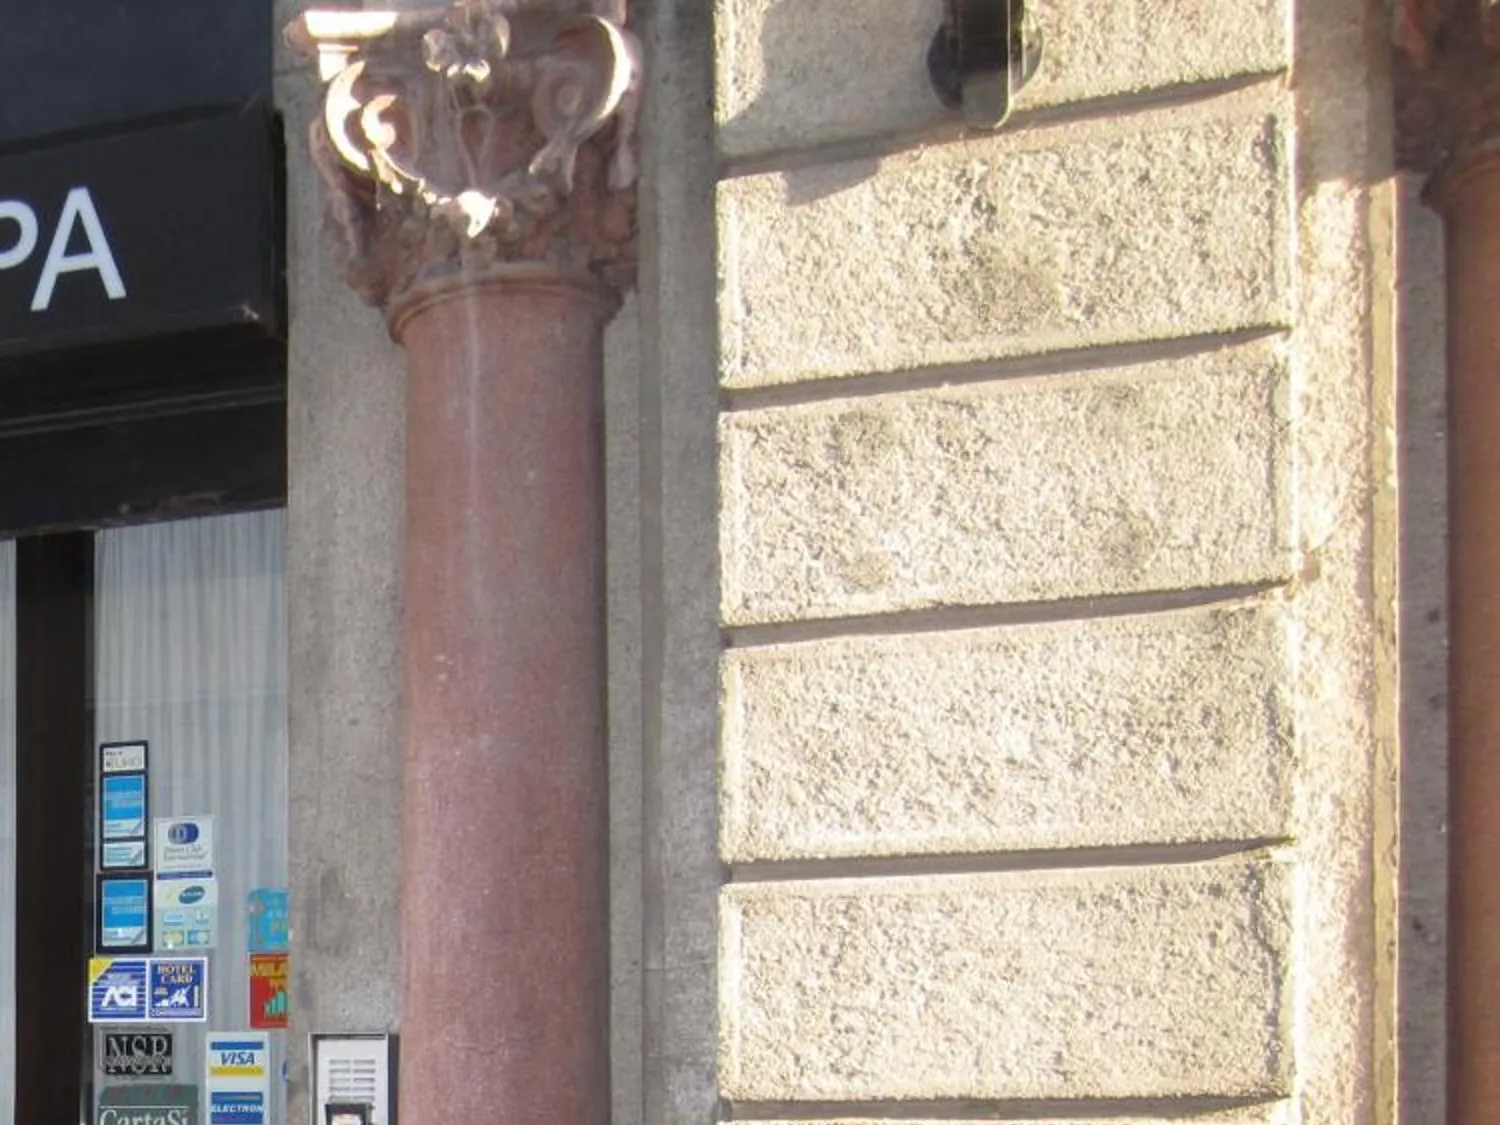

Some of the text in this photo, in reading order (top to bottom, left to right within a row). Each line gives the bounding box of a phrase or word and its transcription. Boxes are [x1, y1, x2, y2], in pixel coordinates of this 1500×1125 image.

[101, 985, 137, 1007] ACI
[220, 1052, 256, 1065] VISA
[211, 1103, 264, 1114] ELECTRON
